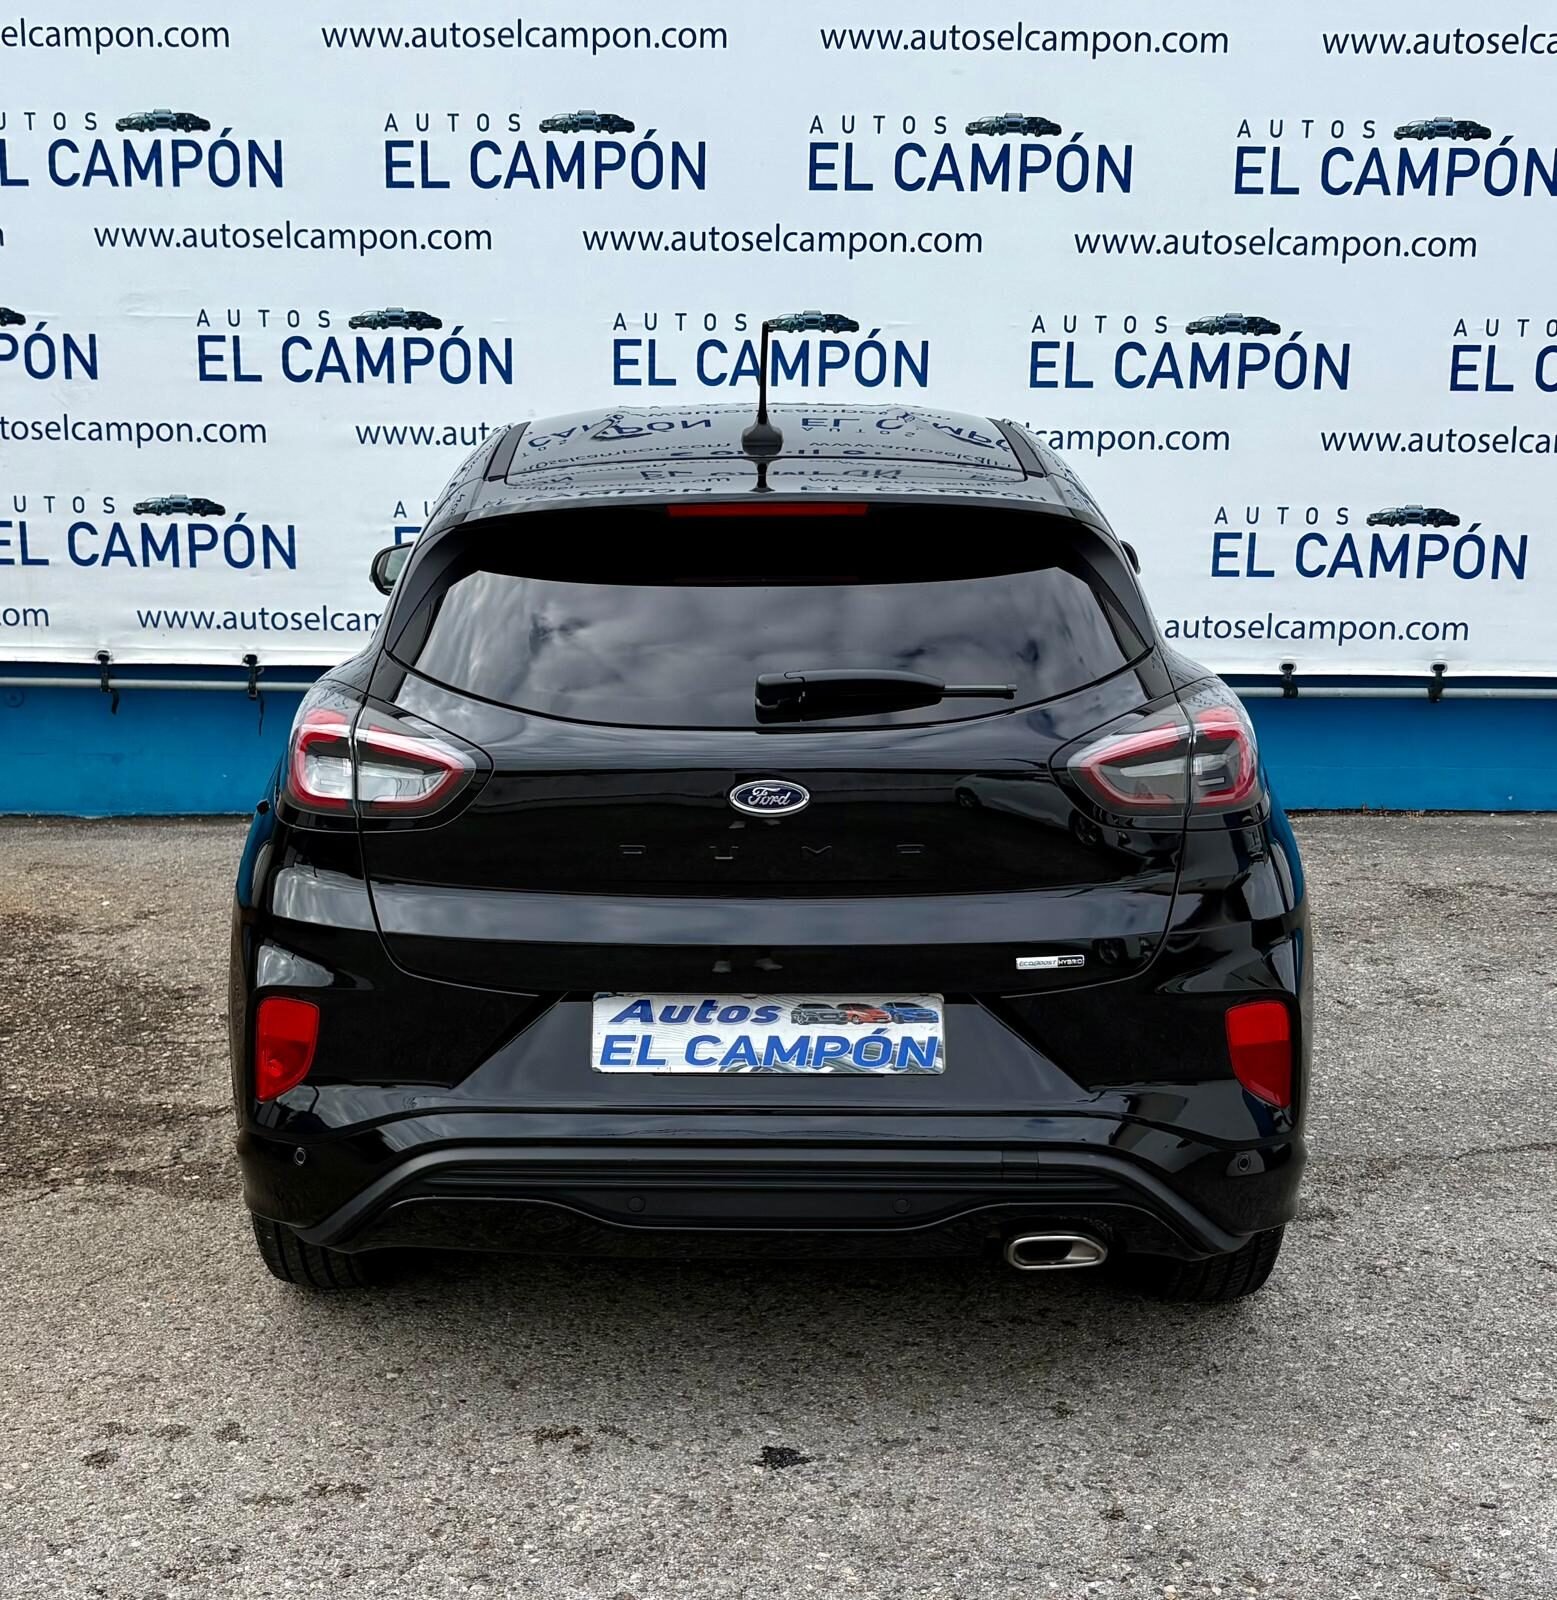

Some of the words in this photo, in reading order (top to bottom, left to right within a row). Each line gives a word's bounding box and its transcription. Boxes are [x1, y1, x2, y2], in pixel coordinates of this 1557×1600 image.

[2, 18, 229, 54] elcampon.com
[322, 19, 726, 55] www.autoselcampon.com
[821, 22, 1228, 59] www.autoselcampon.com
[385, 113, 520, 132] AUTOS
[810, 115, 946, 134] AUTOS
[1237, 119, 1375, 139] AUTOS
[49, 127, 282, 188] CAMPÓN
[385, 140, 450, 188] EL
[471, 128, 705, 190] CAMPÓN
[809, 142, 873, 191] EL
[895, 131, 1132, 193] CAMPÓN
[1235, 146, 1299, 195] EL
[1321, 135, 1557, 196] CAMPÓN
[94, 221, 491, 256] www.autoselcampon.com
[583, 223, 982, 259] www.autoselcampon.com
[1075, 227, 1476, 264] www.autoselcampon.com
[197, 309, 330, 328] AUTOS
[613, 313, 746, 331] AUTOS
[1032, 315, 1167, 333] AUTOS
[198, 335, 262, 382] EL
[282, 325, 512, 384] CAMPÓN
[614, 339, 676, 386] EL
[697, 328, 928, 387] CAMPÓN
[1030, 341, 1093, 388] EL
[1115, 330, 1350, 390] CAMPÓN
[1450, 345, 1514, 391] EL
[1026, 422, 1229, 457] ampon.com
[1321, 426, 1557, 453] www.autoselca
[1215, 507, 1348, 525] AUTOS
[68, 513, 296, 569] CAMPÓN
[1212, 532, 1274, 577] EL
[1296, 522, 1527, 579] CAMPÓN
[747, 786, 791, 807] Ford
[609, 999, 781, 1025] Autos
[600, 1034, 669, 1067] EL
[683, 1027, 942, 1069] CAMPÓN
